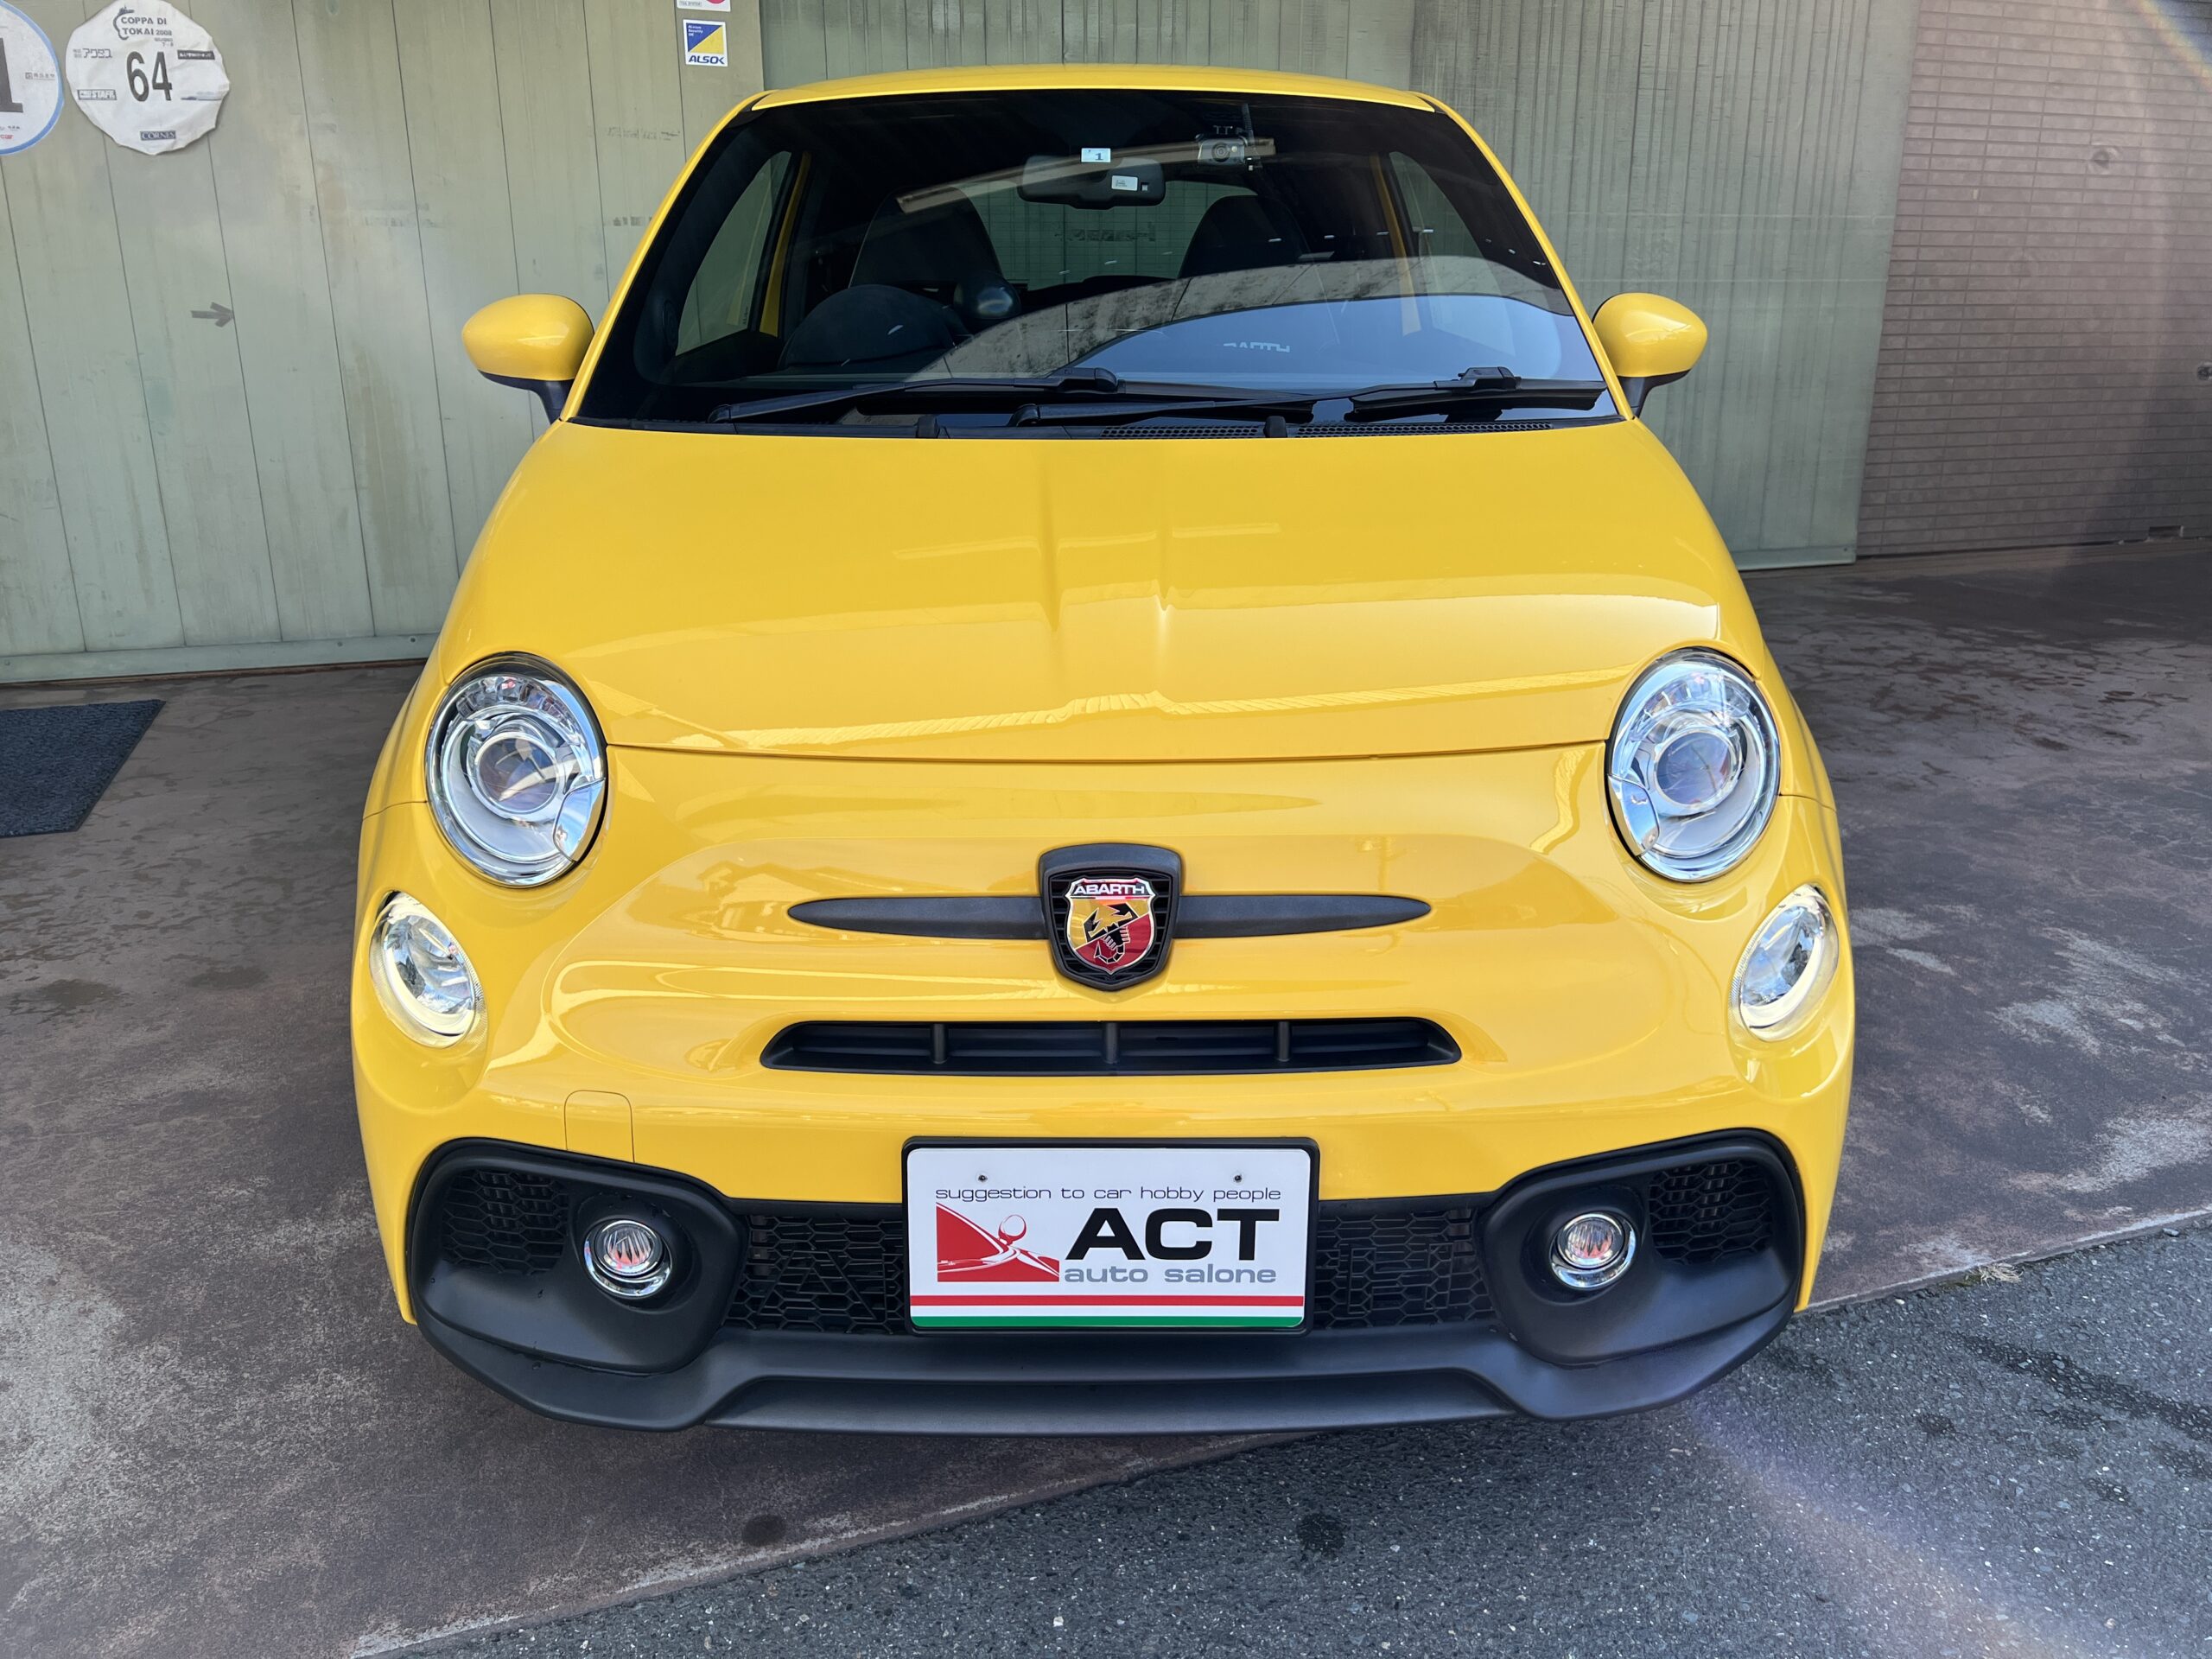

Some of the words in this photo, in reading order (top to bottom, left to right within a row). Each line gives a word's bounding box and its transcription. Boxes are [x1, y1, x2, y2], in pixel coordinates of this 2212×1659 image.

[688, 55, 725, 65] ALSOK
[126, 51, 173, 102] 64
[1073, 883, 1145, 895] ABARTH
[935, 1186, 1052, 1203] suggestion
[1061, 1186, 1085, 1200] to
[1094, 1189, 1132, 1200] car
[1141, 1186, 1205, 1203] hobby
[1213, 1187, 1281, 1203] people
[1065, 1207, 1280, 1262] ACT
[1065, 1265, 1148, 1284] auto
[1164, 1263, 1276, 1284] salone
